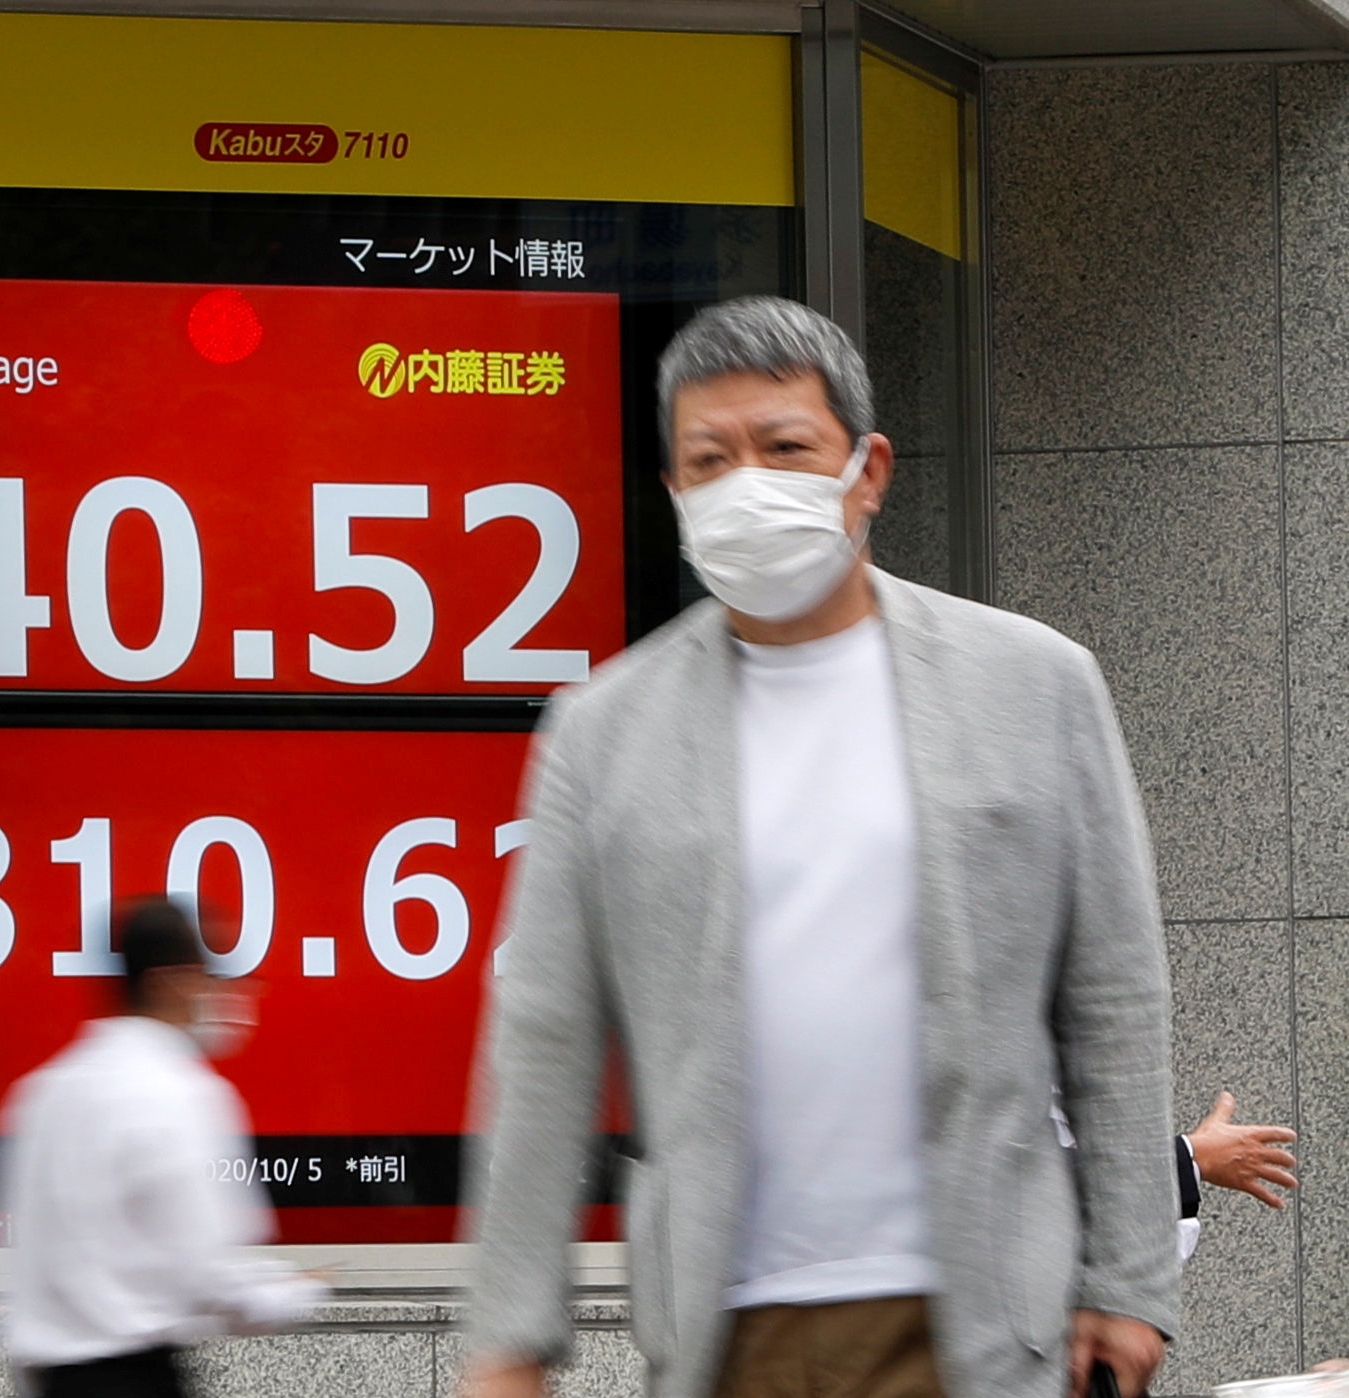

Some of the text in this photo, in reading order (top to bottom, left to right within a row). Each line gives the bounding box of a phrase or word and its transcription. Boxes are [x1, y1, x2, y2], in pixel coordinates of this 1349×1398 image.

[208, 128, 409, 160] Kabuスタ 7110
[339, 237, 586, 280] マーケット情報
[407, 349, 566, 395] 内藤証券
